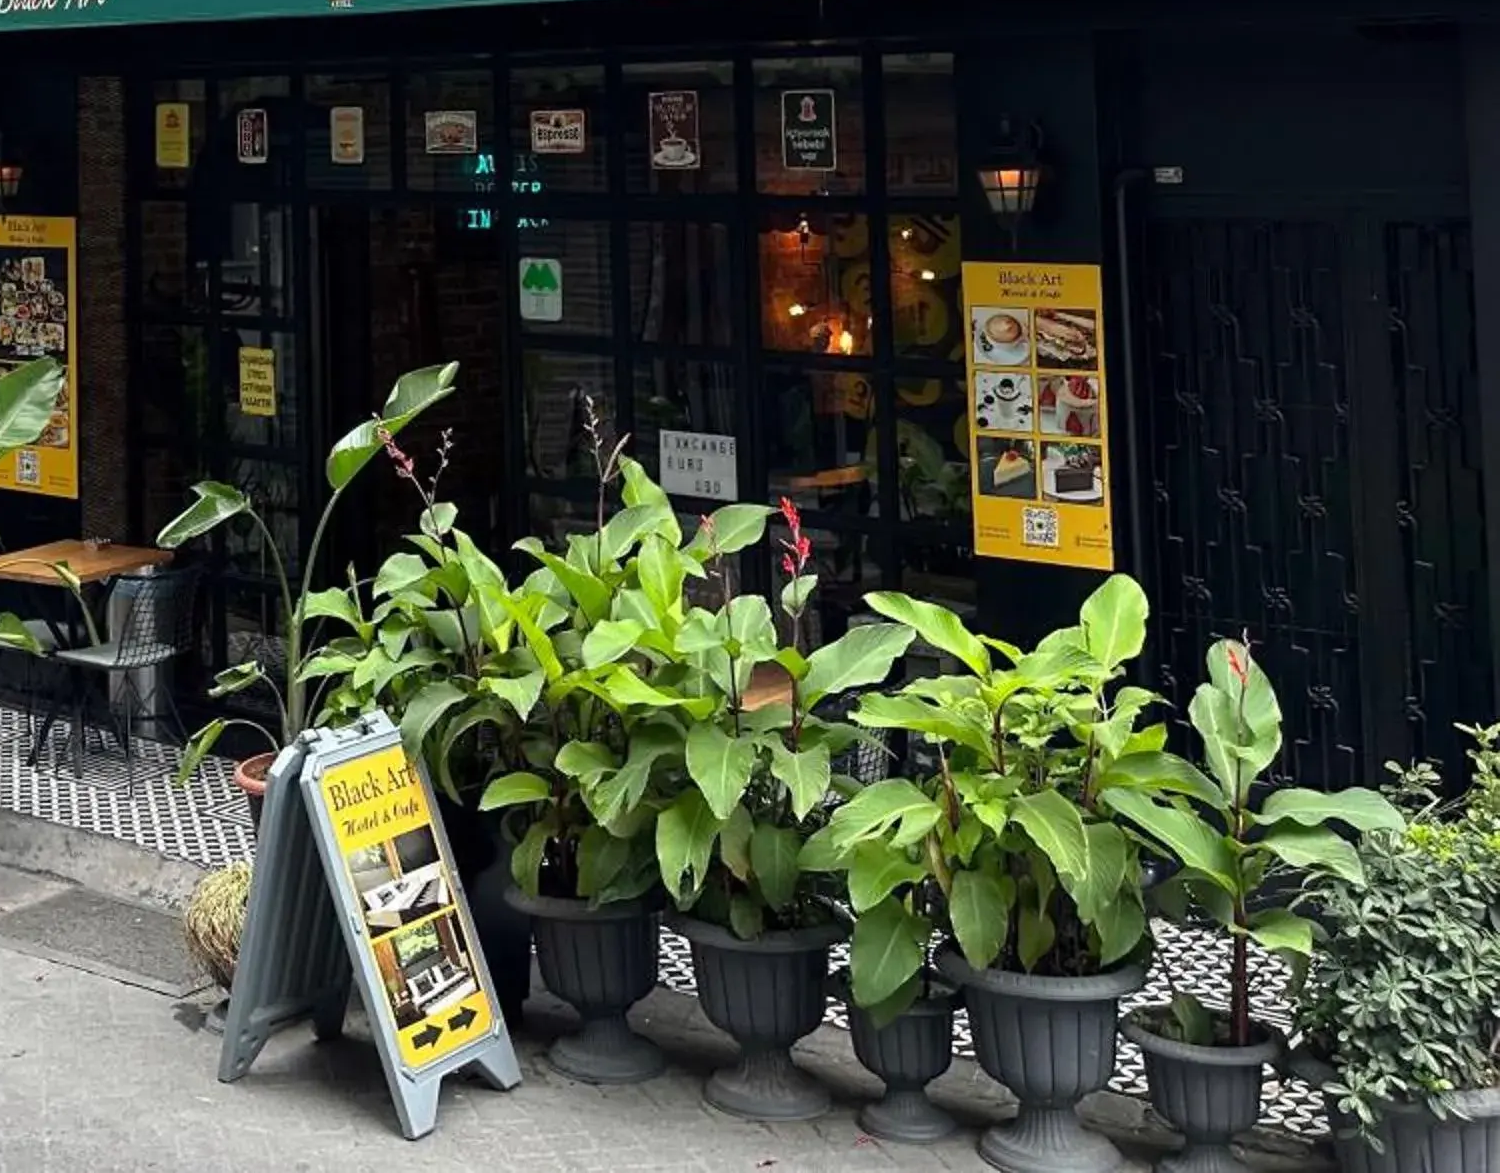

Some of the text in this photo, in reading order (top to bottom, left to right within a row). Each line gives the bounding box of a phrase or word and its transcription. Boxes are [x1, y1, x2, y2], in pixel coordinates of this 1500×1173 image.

[1040, 272, 1064, 286] Art
[328, 762, 418, 813] Black Art
